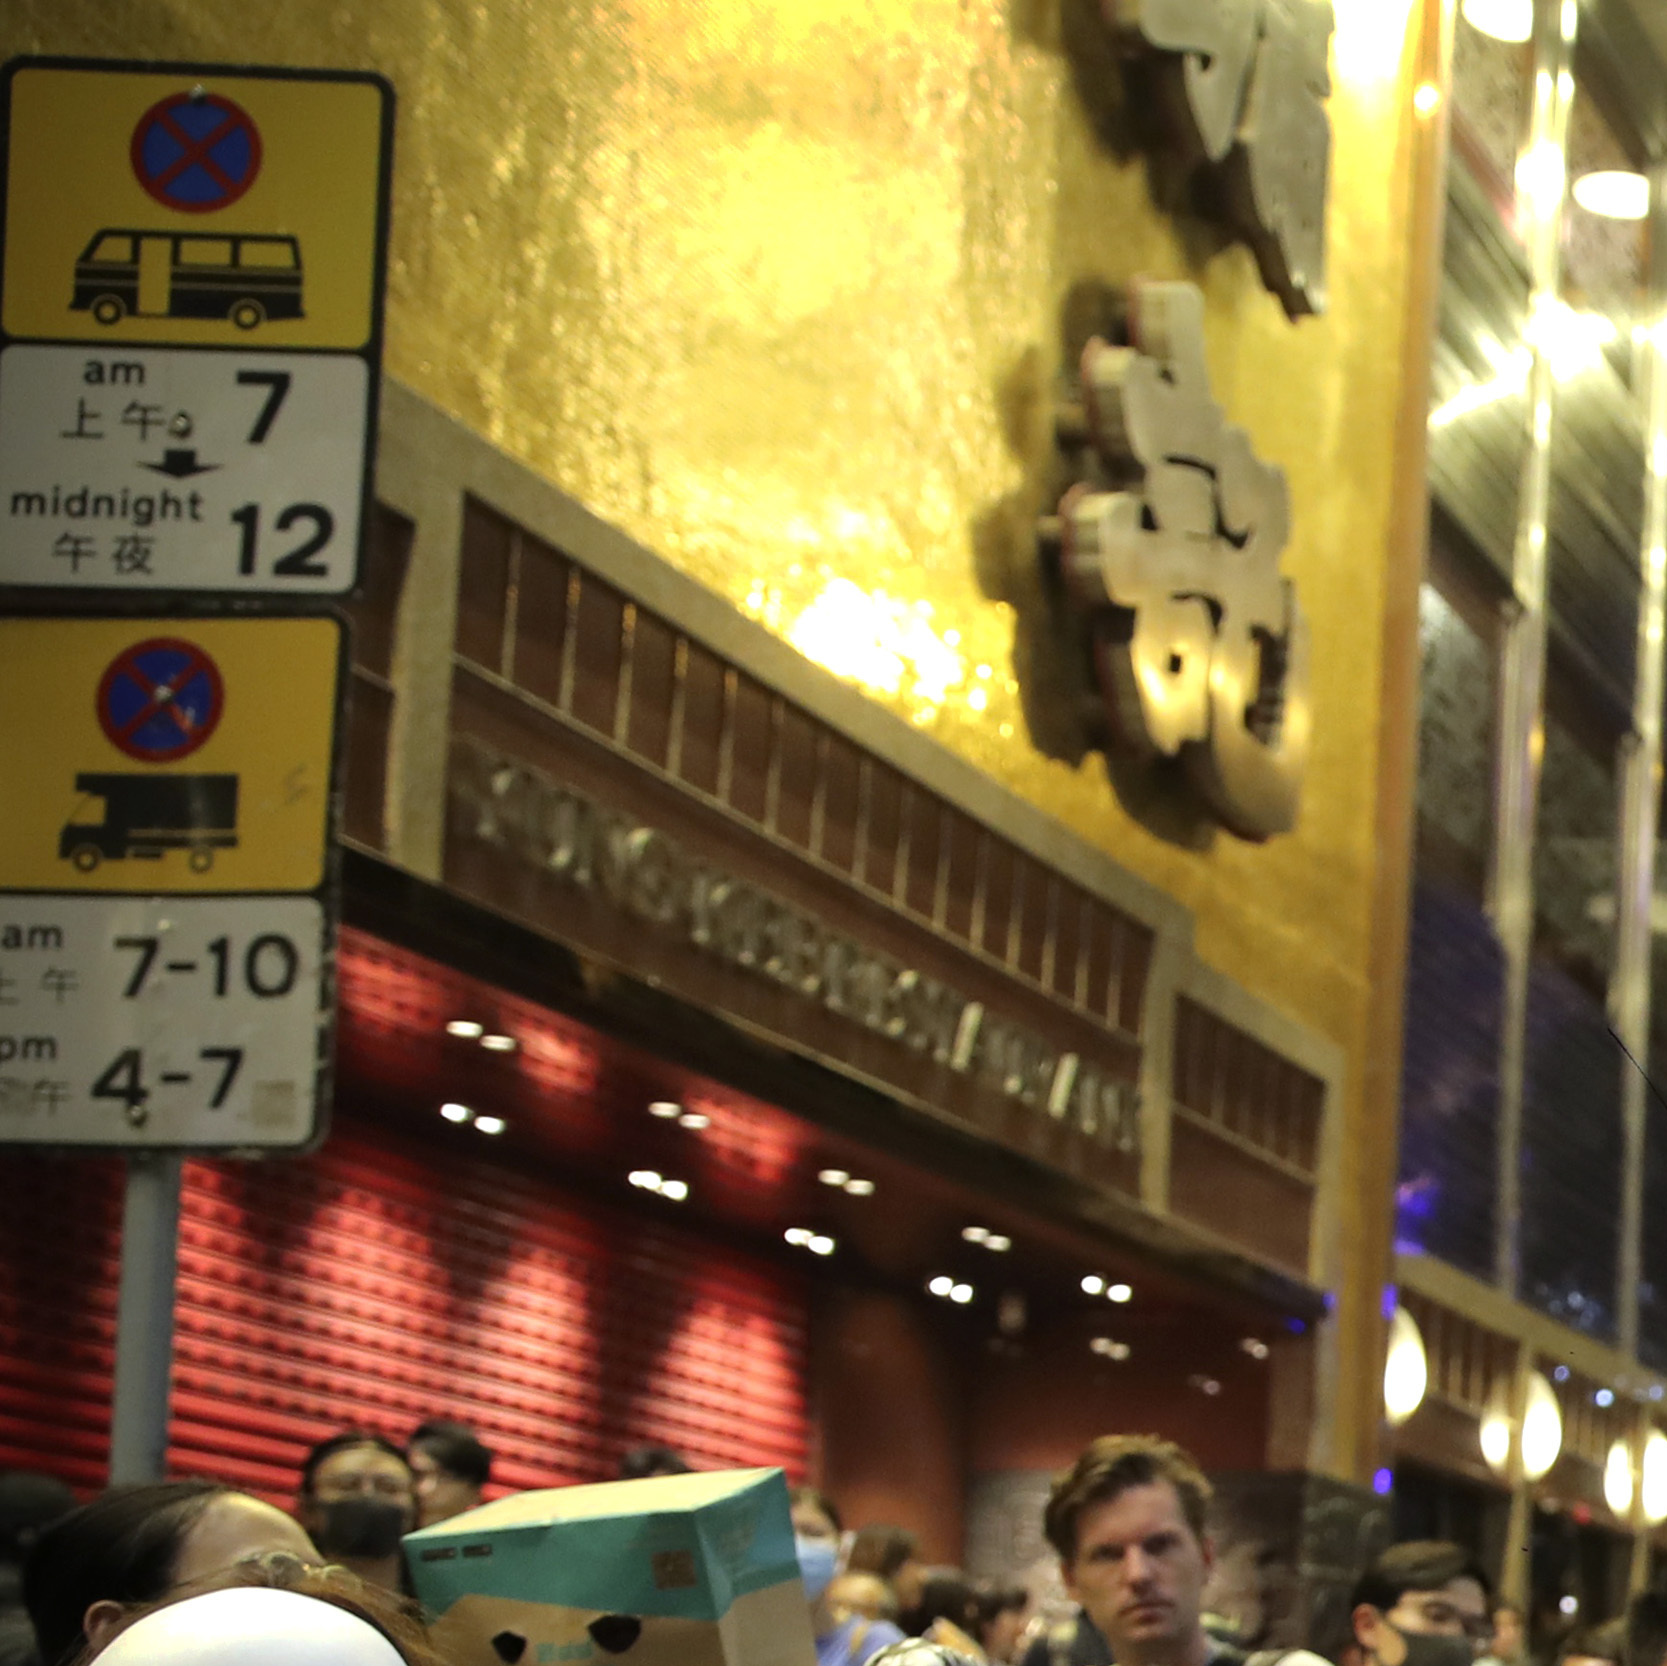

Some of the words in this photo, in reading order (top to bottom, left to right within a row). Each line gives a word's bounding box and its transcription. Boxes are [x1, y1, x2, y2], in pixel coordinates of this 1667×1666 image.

[59, 396, 166, 441] 上午
[83, 358, 146, 386] am
[236, 368, 291, 444] 7
[9, 484, 205, 527] midnight
[230, 502, 334, 577] 12
[52, 530, 155, 575] 午夜
[1, 924, 64, 950] am
[112, 932, 298, 999] 7-10
[90, 1047, 244, 1112] 4-7
